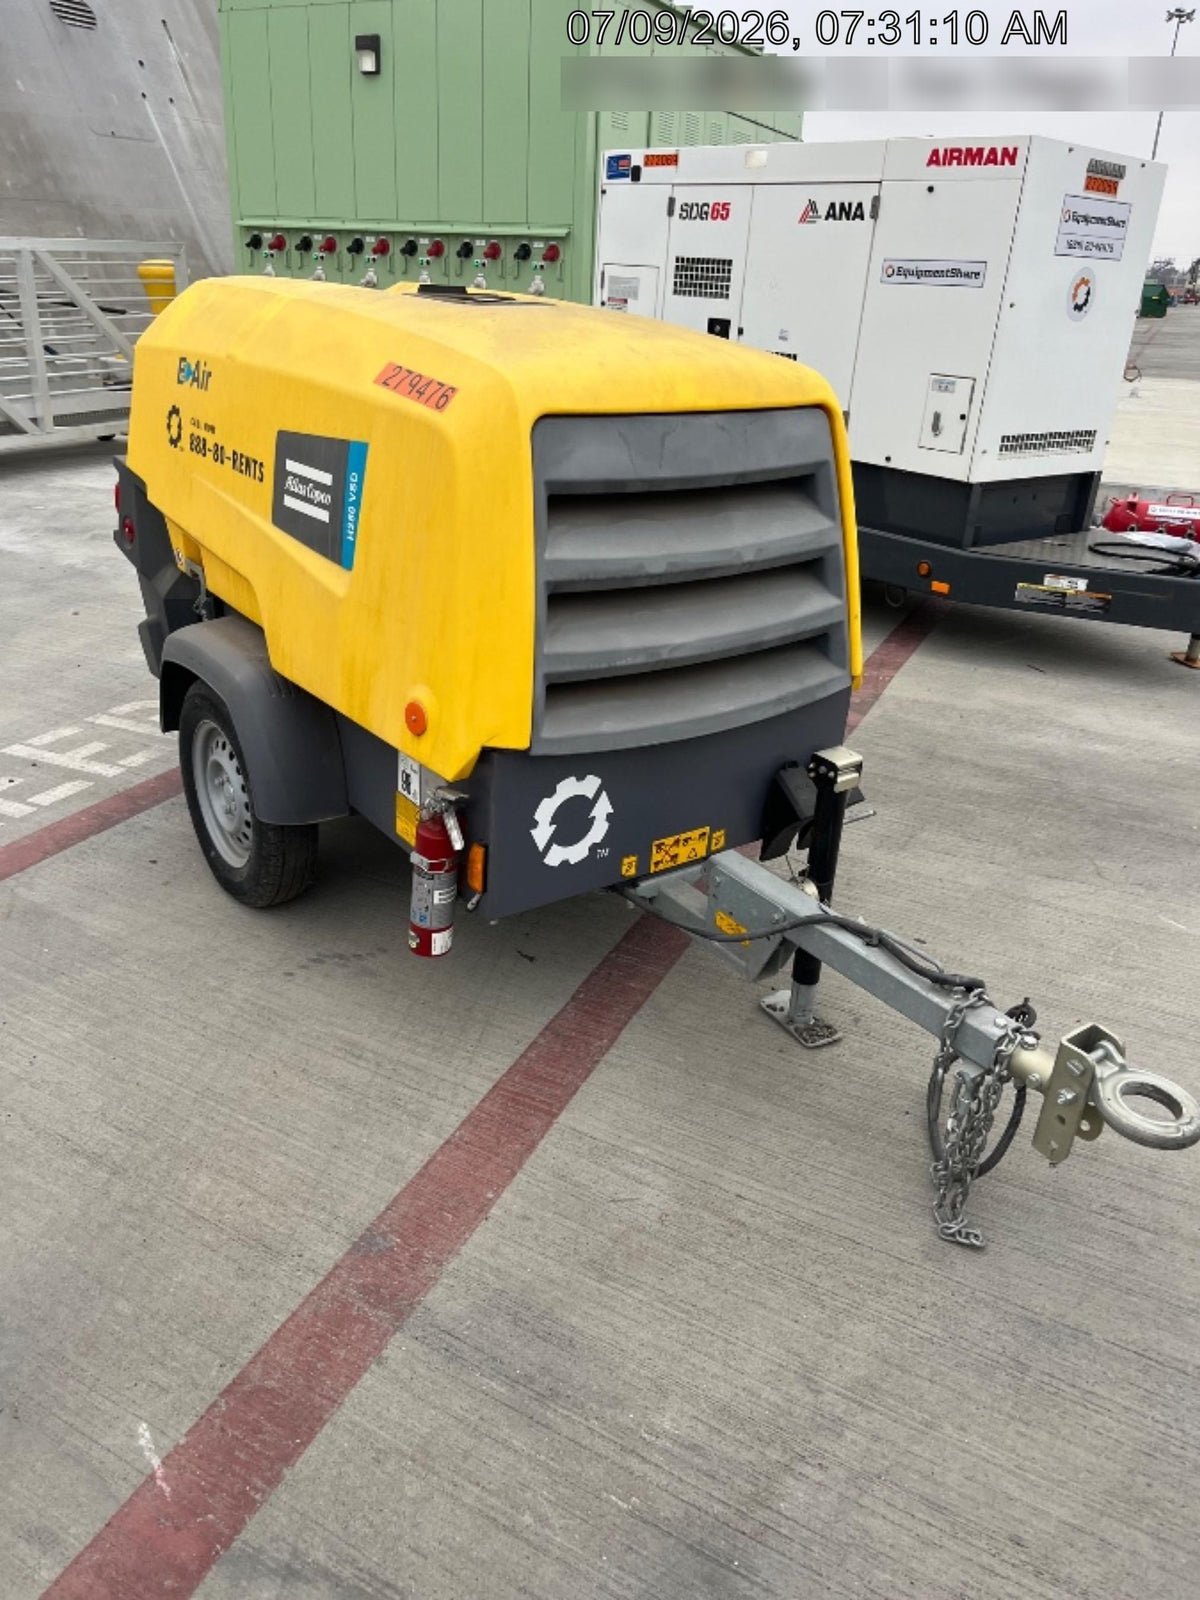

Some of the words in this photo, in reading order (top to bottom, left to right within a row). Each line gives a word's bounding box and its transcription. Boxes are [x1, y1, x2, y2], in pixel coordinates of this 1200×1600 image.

[926, 147, 1018, 167] AIRMAN
[679, 202, 731, 221] SDG65
[824, 202, 865, 221] ANA
[896, 266, 980, 280] EquipmentShare
[381, 365, 456, 410] 279476
[189, 433, 264, 483] 888-80-RENTS
[284, 476, 307, 498] Atlas
[307, 482, 332, 505] Copco
[348, 472, 359, 502] VSD
